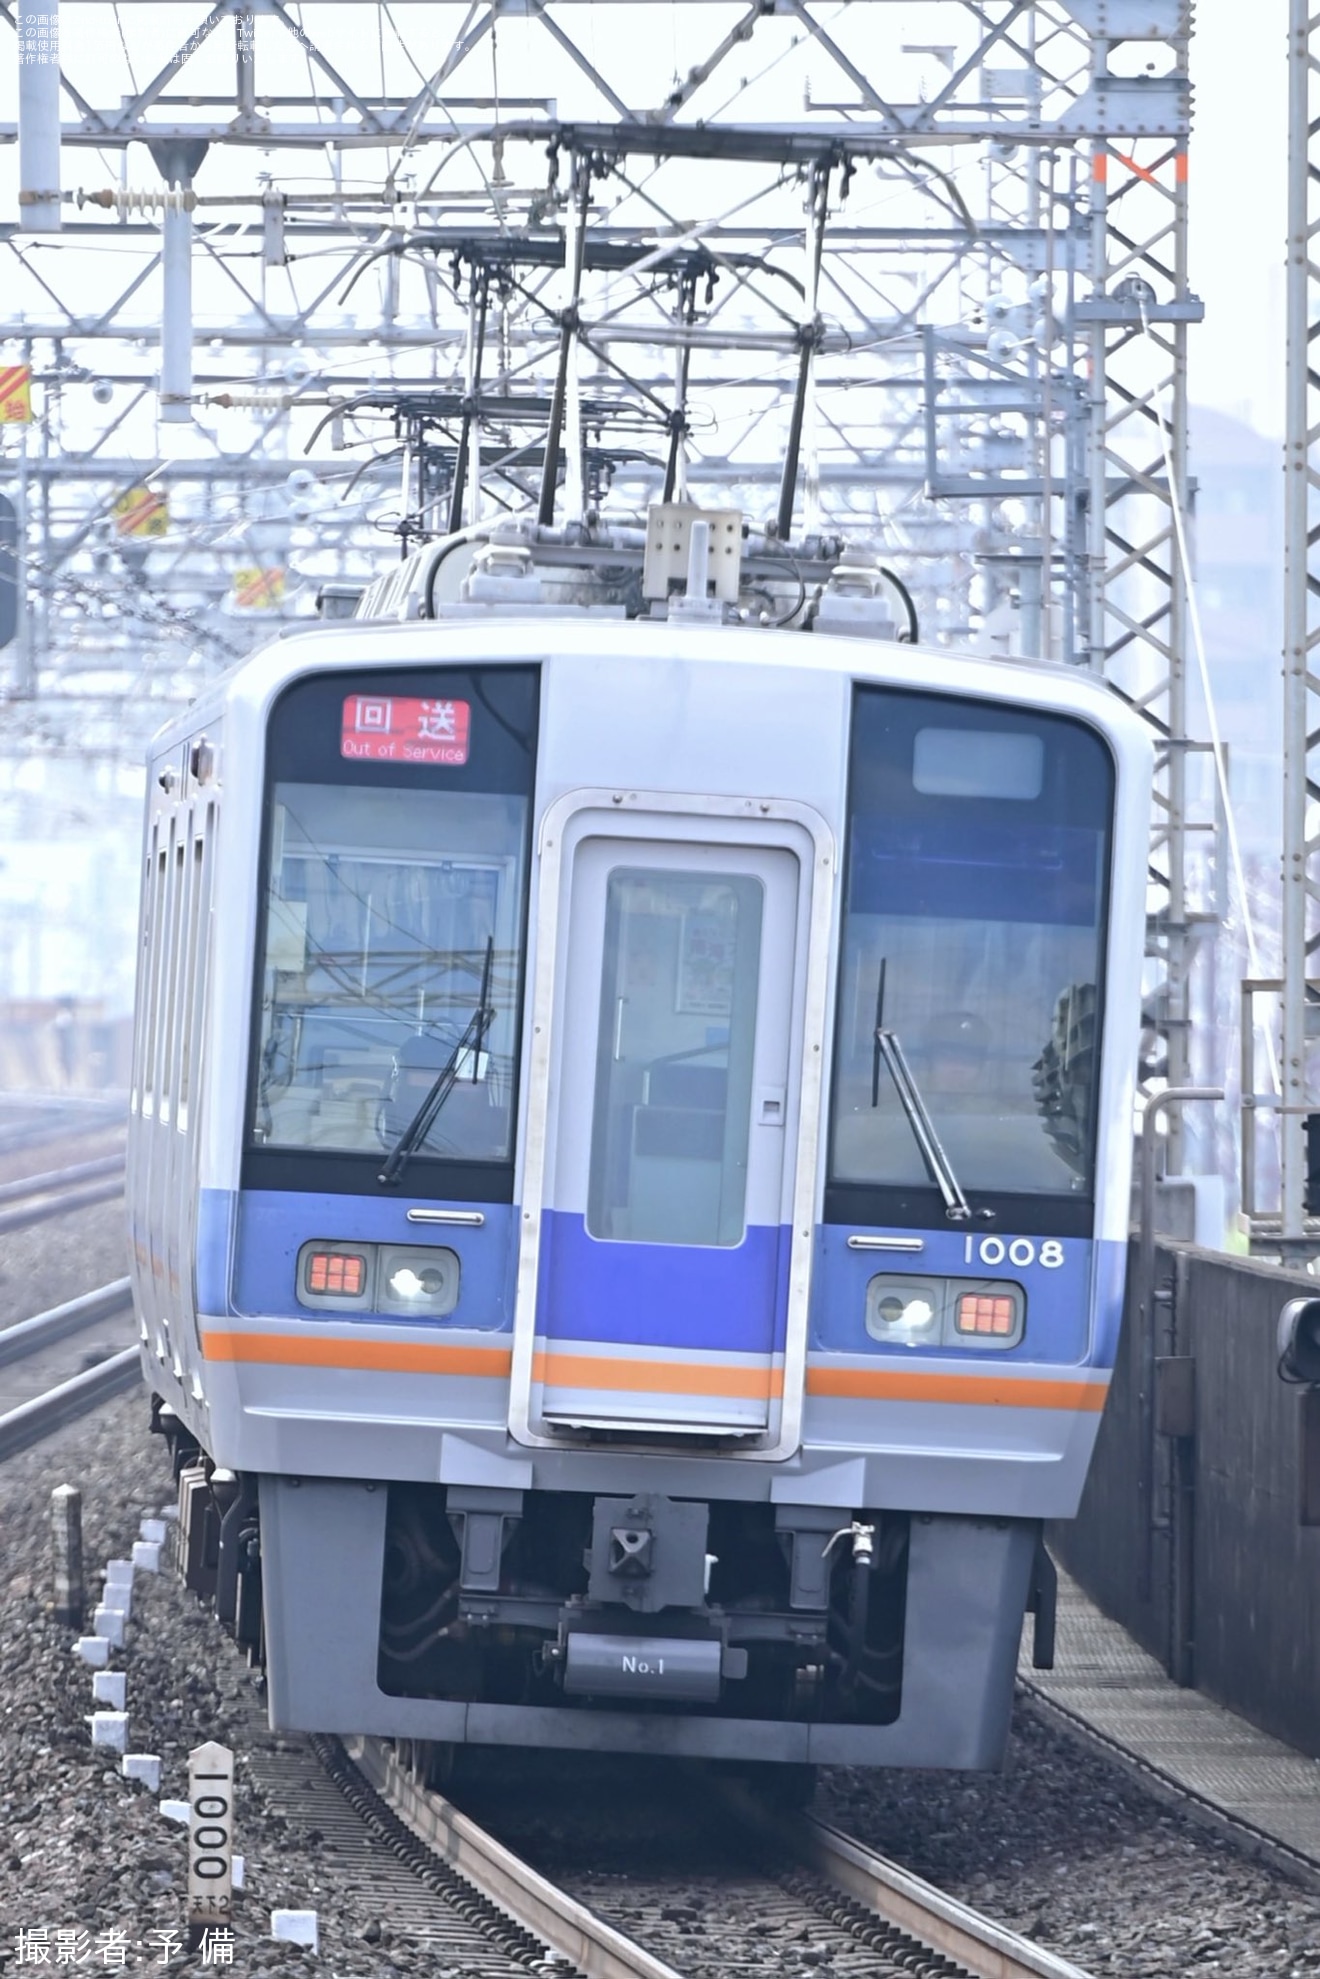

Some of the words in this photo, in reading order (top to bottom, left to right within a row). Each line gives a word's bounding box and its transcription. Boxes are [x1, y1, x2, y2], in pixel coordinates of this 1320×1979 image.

[355, 696, 456, 741] 回送
[342, 739, 370, 757] Out
[378, 741, 396, 758] of
[403, 745, 465, 762] Service
[965, 1235, 1065, 1268] 1008
[622, 1655, 665, 1675] No.1
